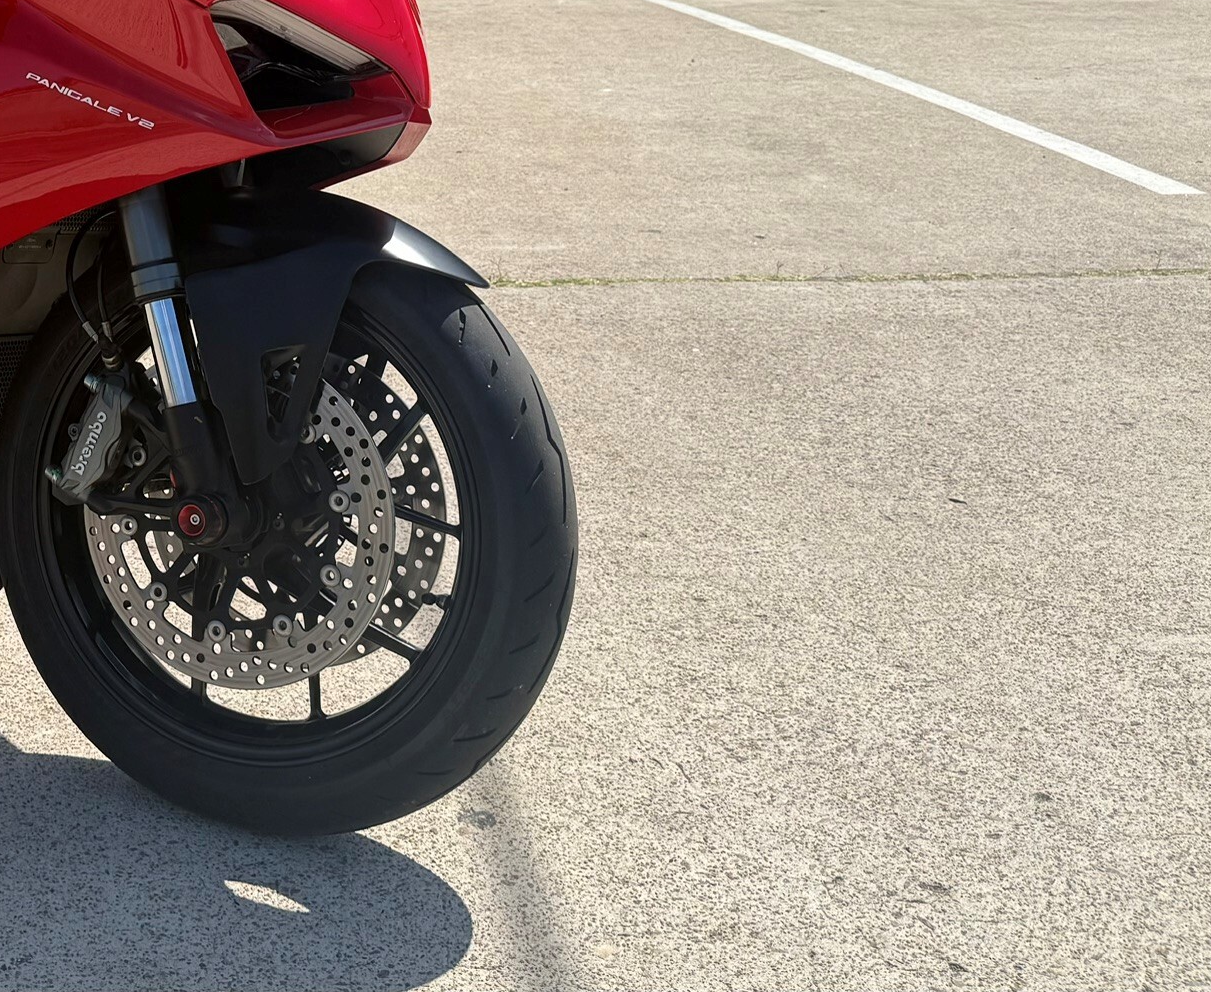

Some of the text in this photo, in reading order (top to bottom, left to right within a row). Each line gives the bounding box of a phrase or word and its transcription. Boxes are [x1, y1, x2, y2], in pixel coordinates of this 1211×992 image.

[25, 71, 155, 131] PANIGALE V2
[70, 410, 108, 476] brembo
